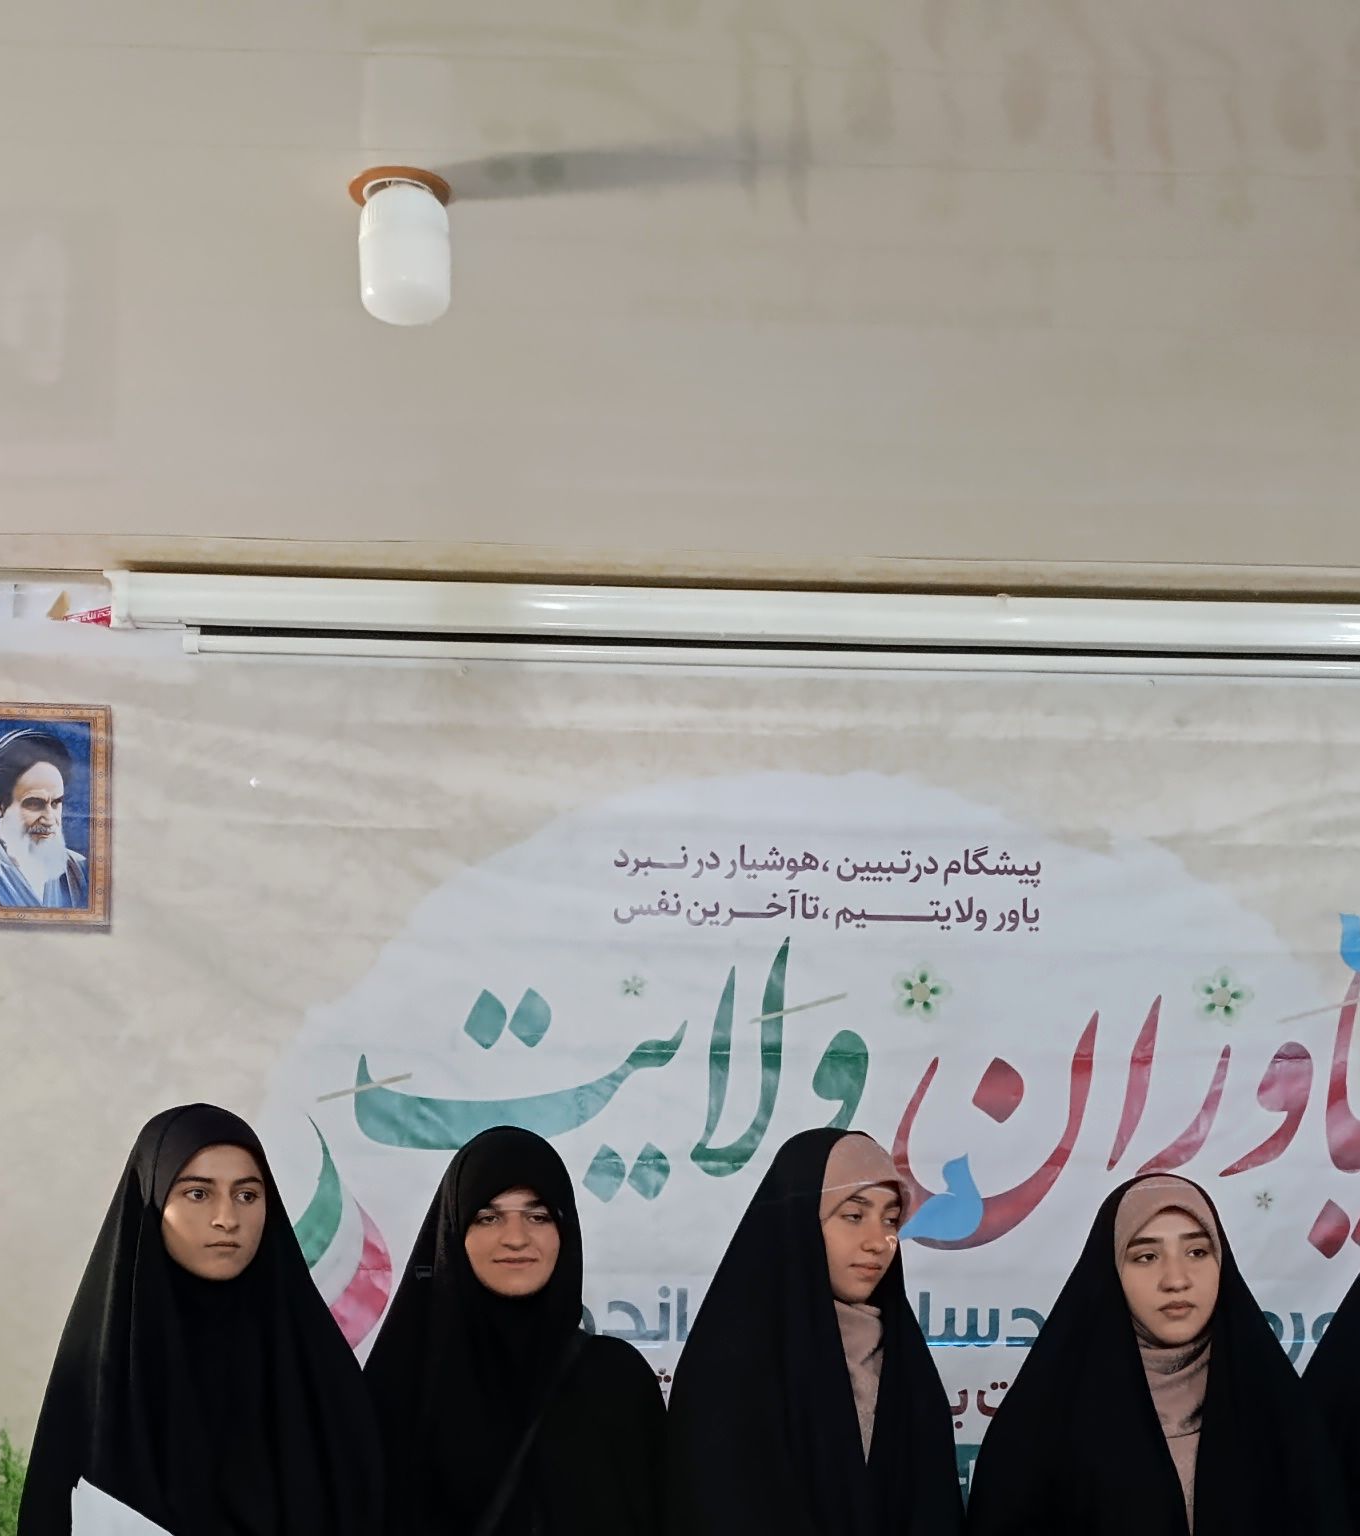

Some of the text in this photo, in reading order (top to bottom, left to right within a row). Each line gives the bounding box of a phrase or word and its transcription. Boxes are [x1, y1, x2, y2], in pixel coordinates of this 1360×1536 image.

[613, 845, 688, 877] نبرد
[691, 850, 720, 878] در
[943, 846, 1041, 888] پیشگام
[613, 890, 682, 925] نفس
[993, 896, 1040, 932] یاور
[354, 936, 869, 1203] ولایت
